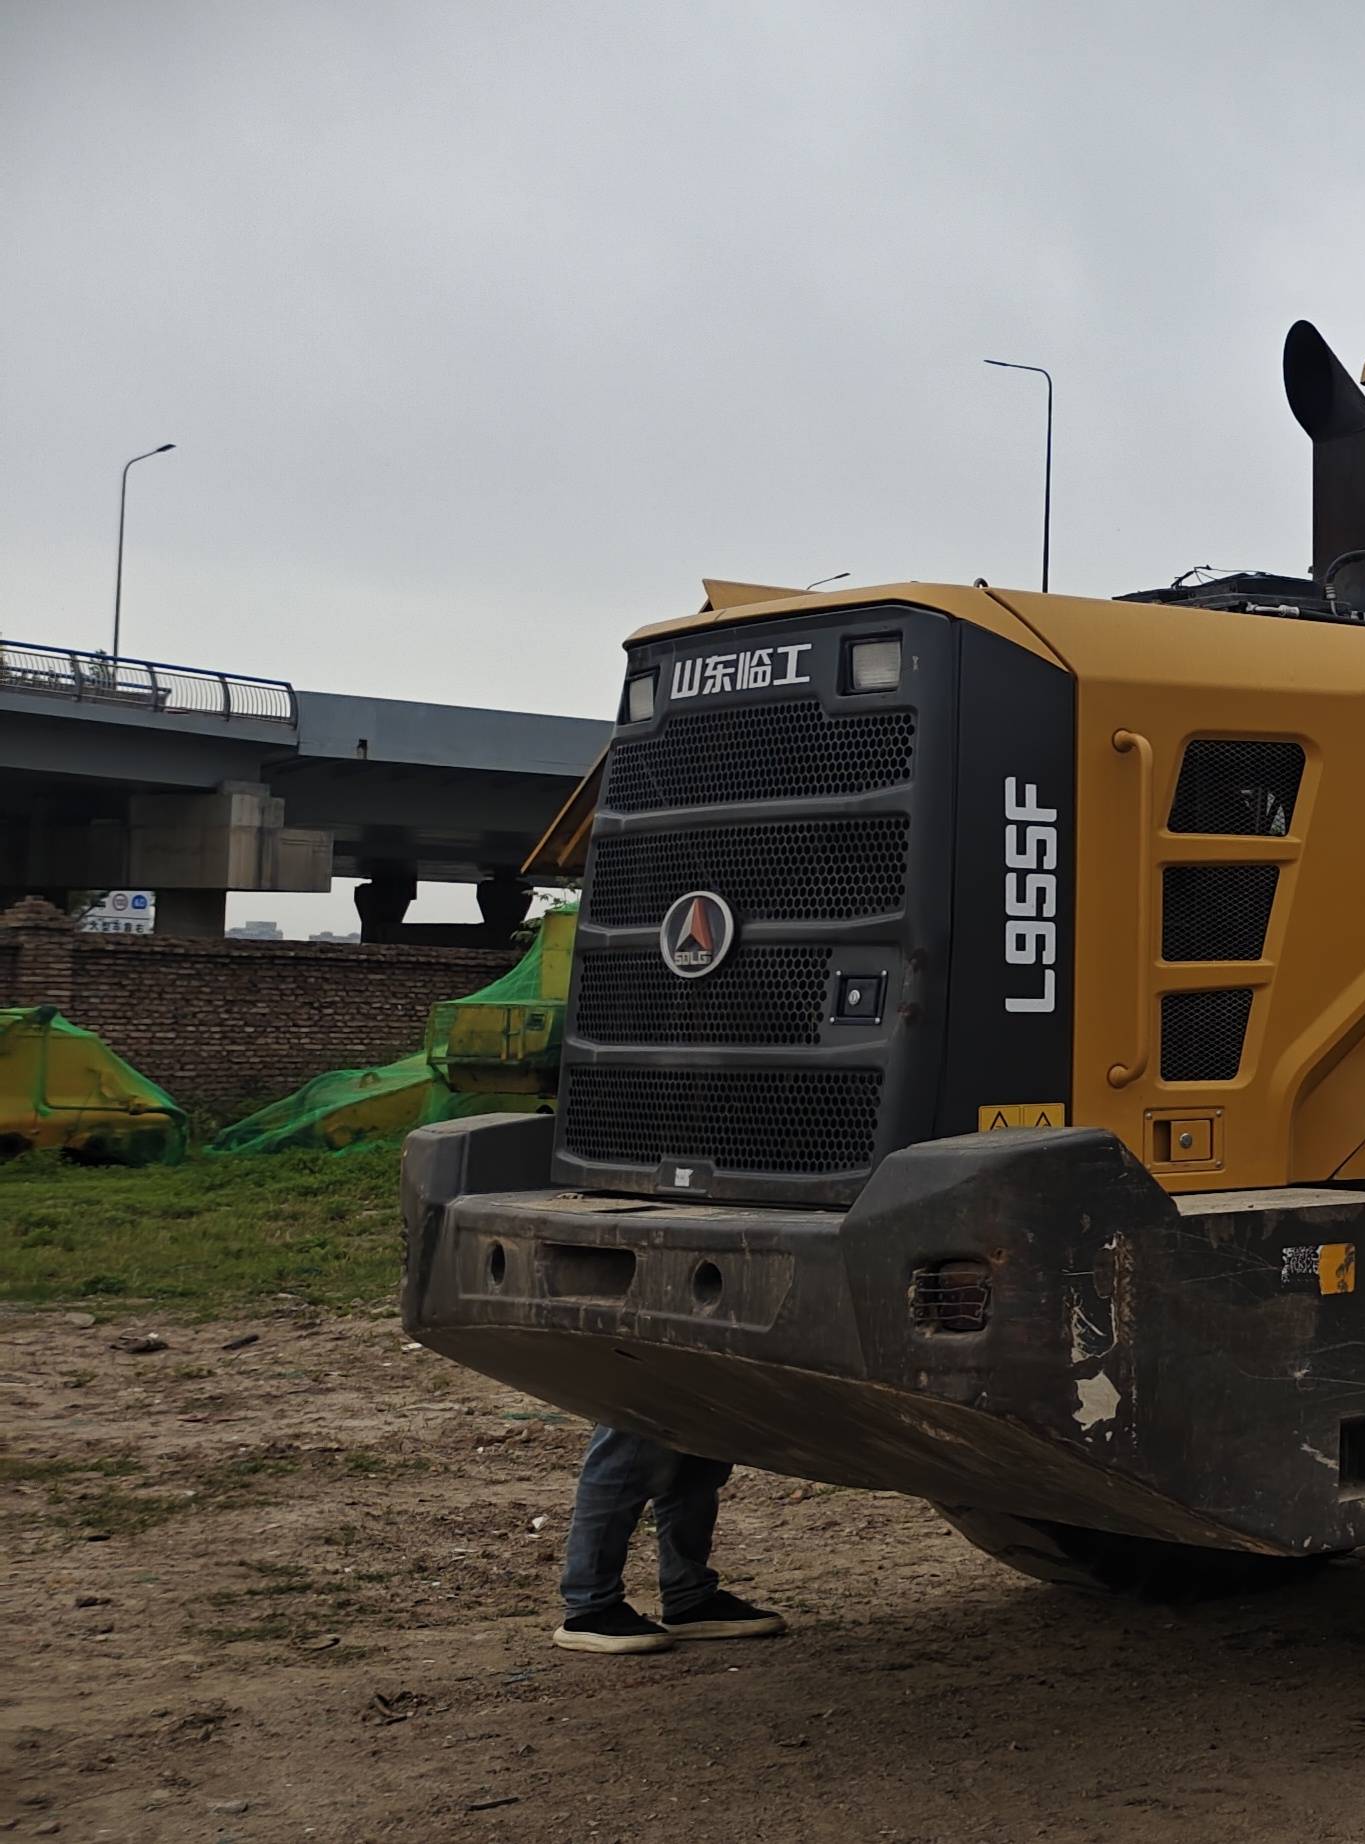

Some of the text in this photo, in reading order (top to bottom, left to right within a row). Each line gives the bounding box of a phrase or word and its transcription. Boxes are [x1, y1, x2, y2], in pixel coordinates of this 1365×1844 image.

[670, 643, 812, 700] 山东临工
[1005, 776, 1057, 1012] L955F
[674, 950, 713, 966] SDLG
